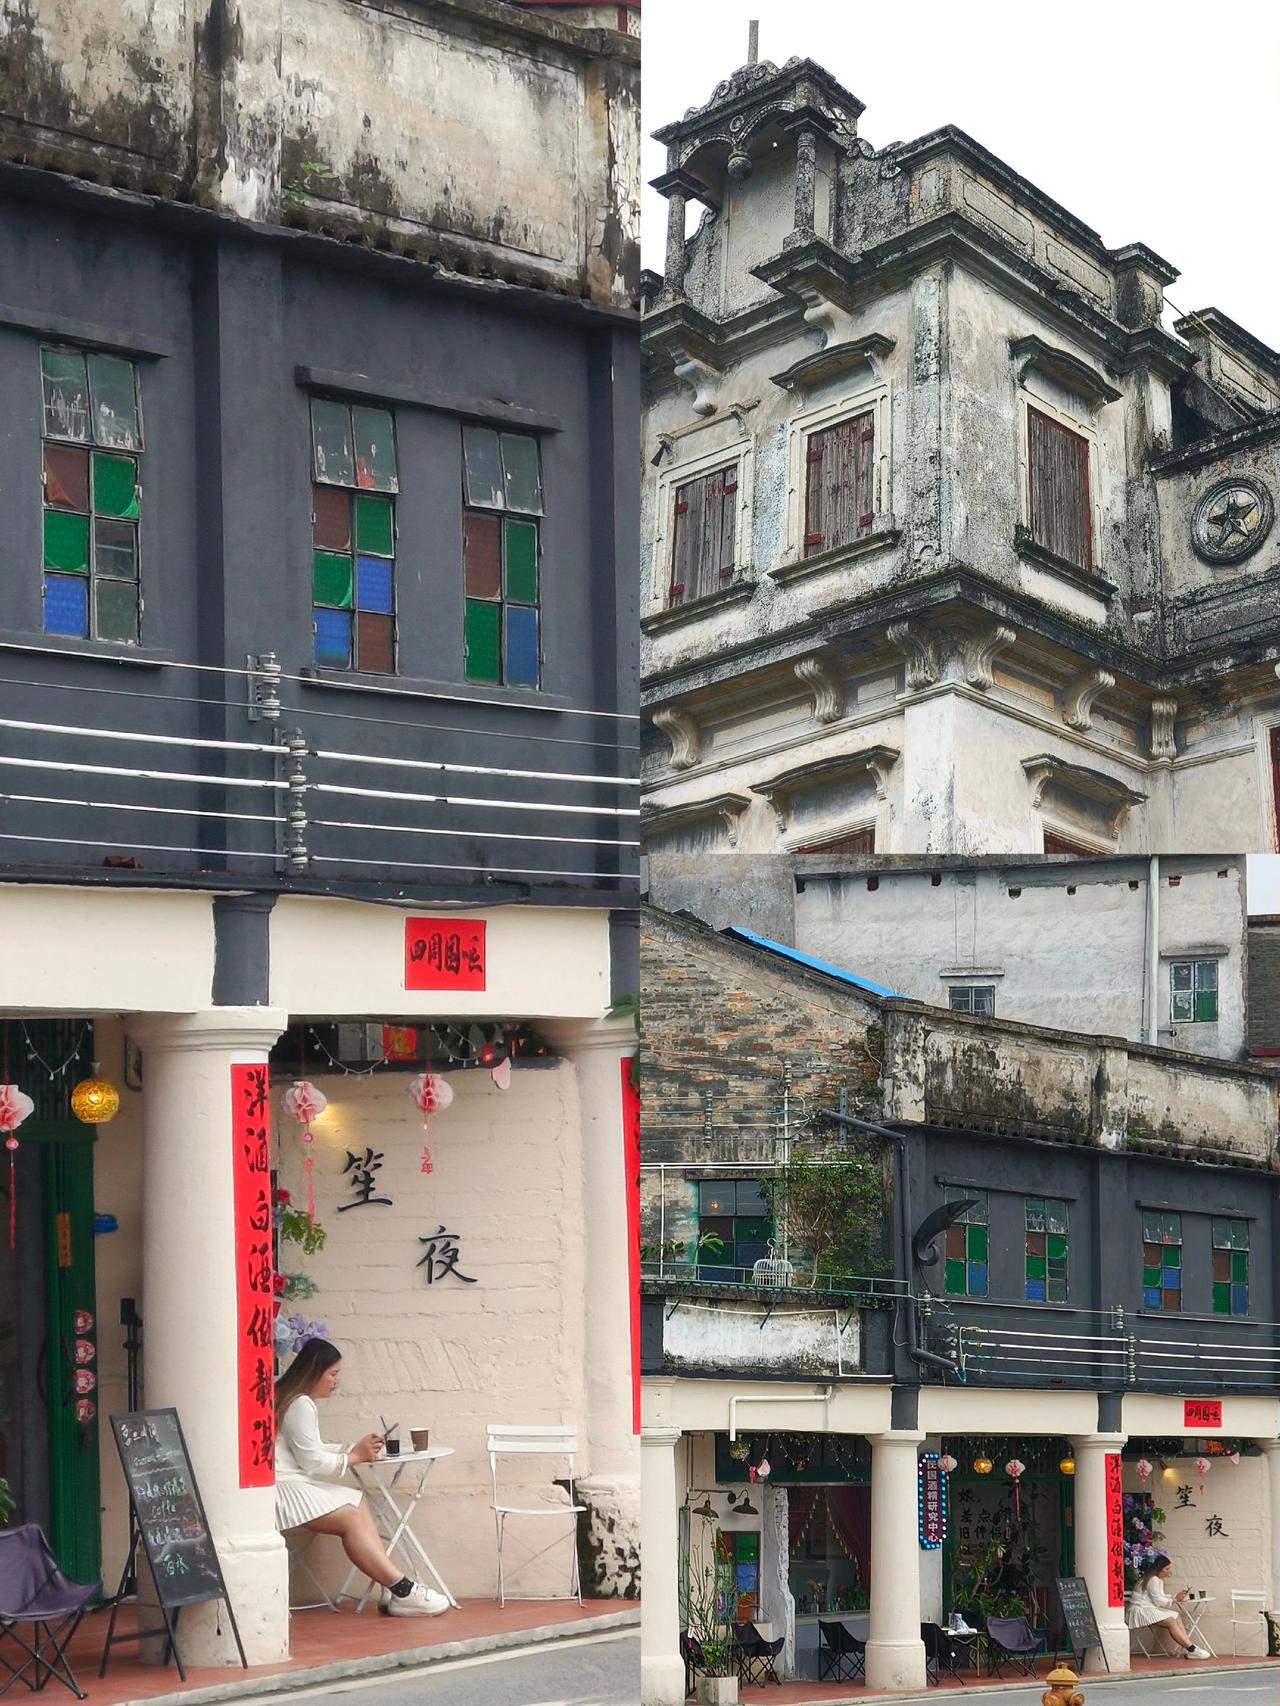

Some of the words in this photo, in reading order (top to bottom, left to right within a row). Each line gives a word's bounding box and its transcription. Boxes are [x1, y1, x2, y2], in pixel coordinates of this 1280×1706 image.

[337, 1147, 393, 1212] 笙
[415, 1224, 478, 1284] 夜
[926, 1460, 939, 1543] 民国酒精研究中心
[1174, 1484, 1197, 1510] 笙
[1205, 1514, 1230, 1537] 夜
